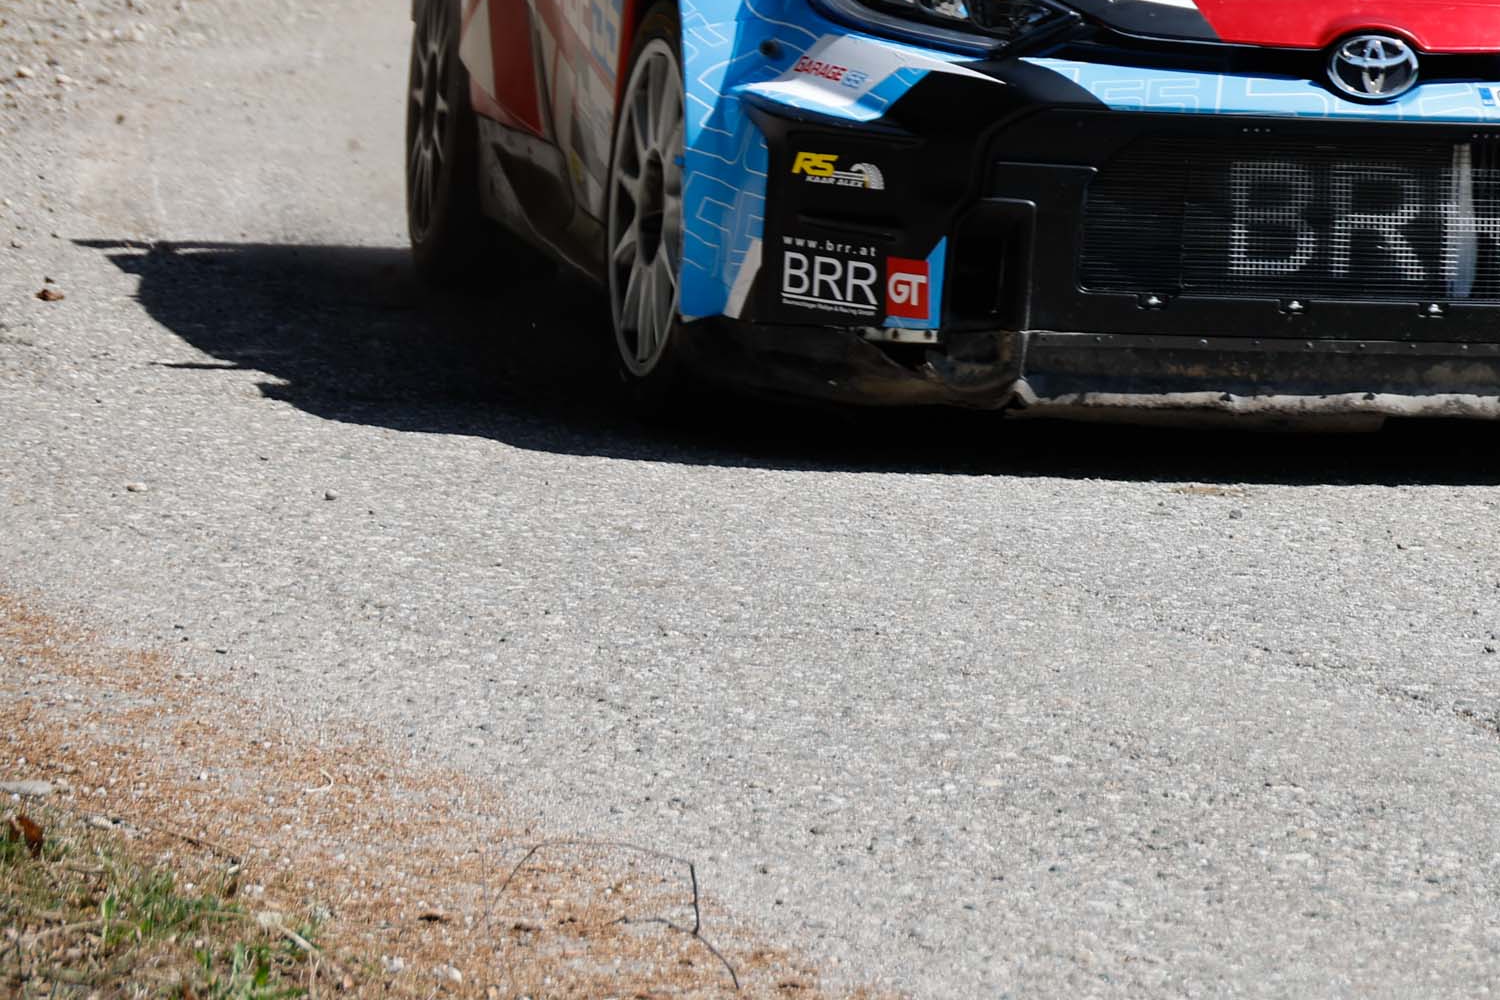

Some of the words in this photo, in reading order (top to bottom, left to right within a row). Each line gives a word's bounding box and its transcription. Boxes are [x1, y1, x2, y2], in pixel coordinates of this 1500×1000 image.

[794, 56, 847, 81] GARAGE
[792, 151, 839, 177] RS
[836, 179, 864, 188] ALEX
[783, 236, 876, 256] www.brr.at
[782, 251, 878, 305] BRR
[888, 272, 927, 306] GT
